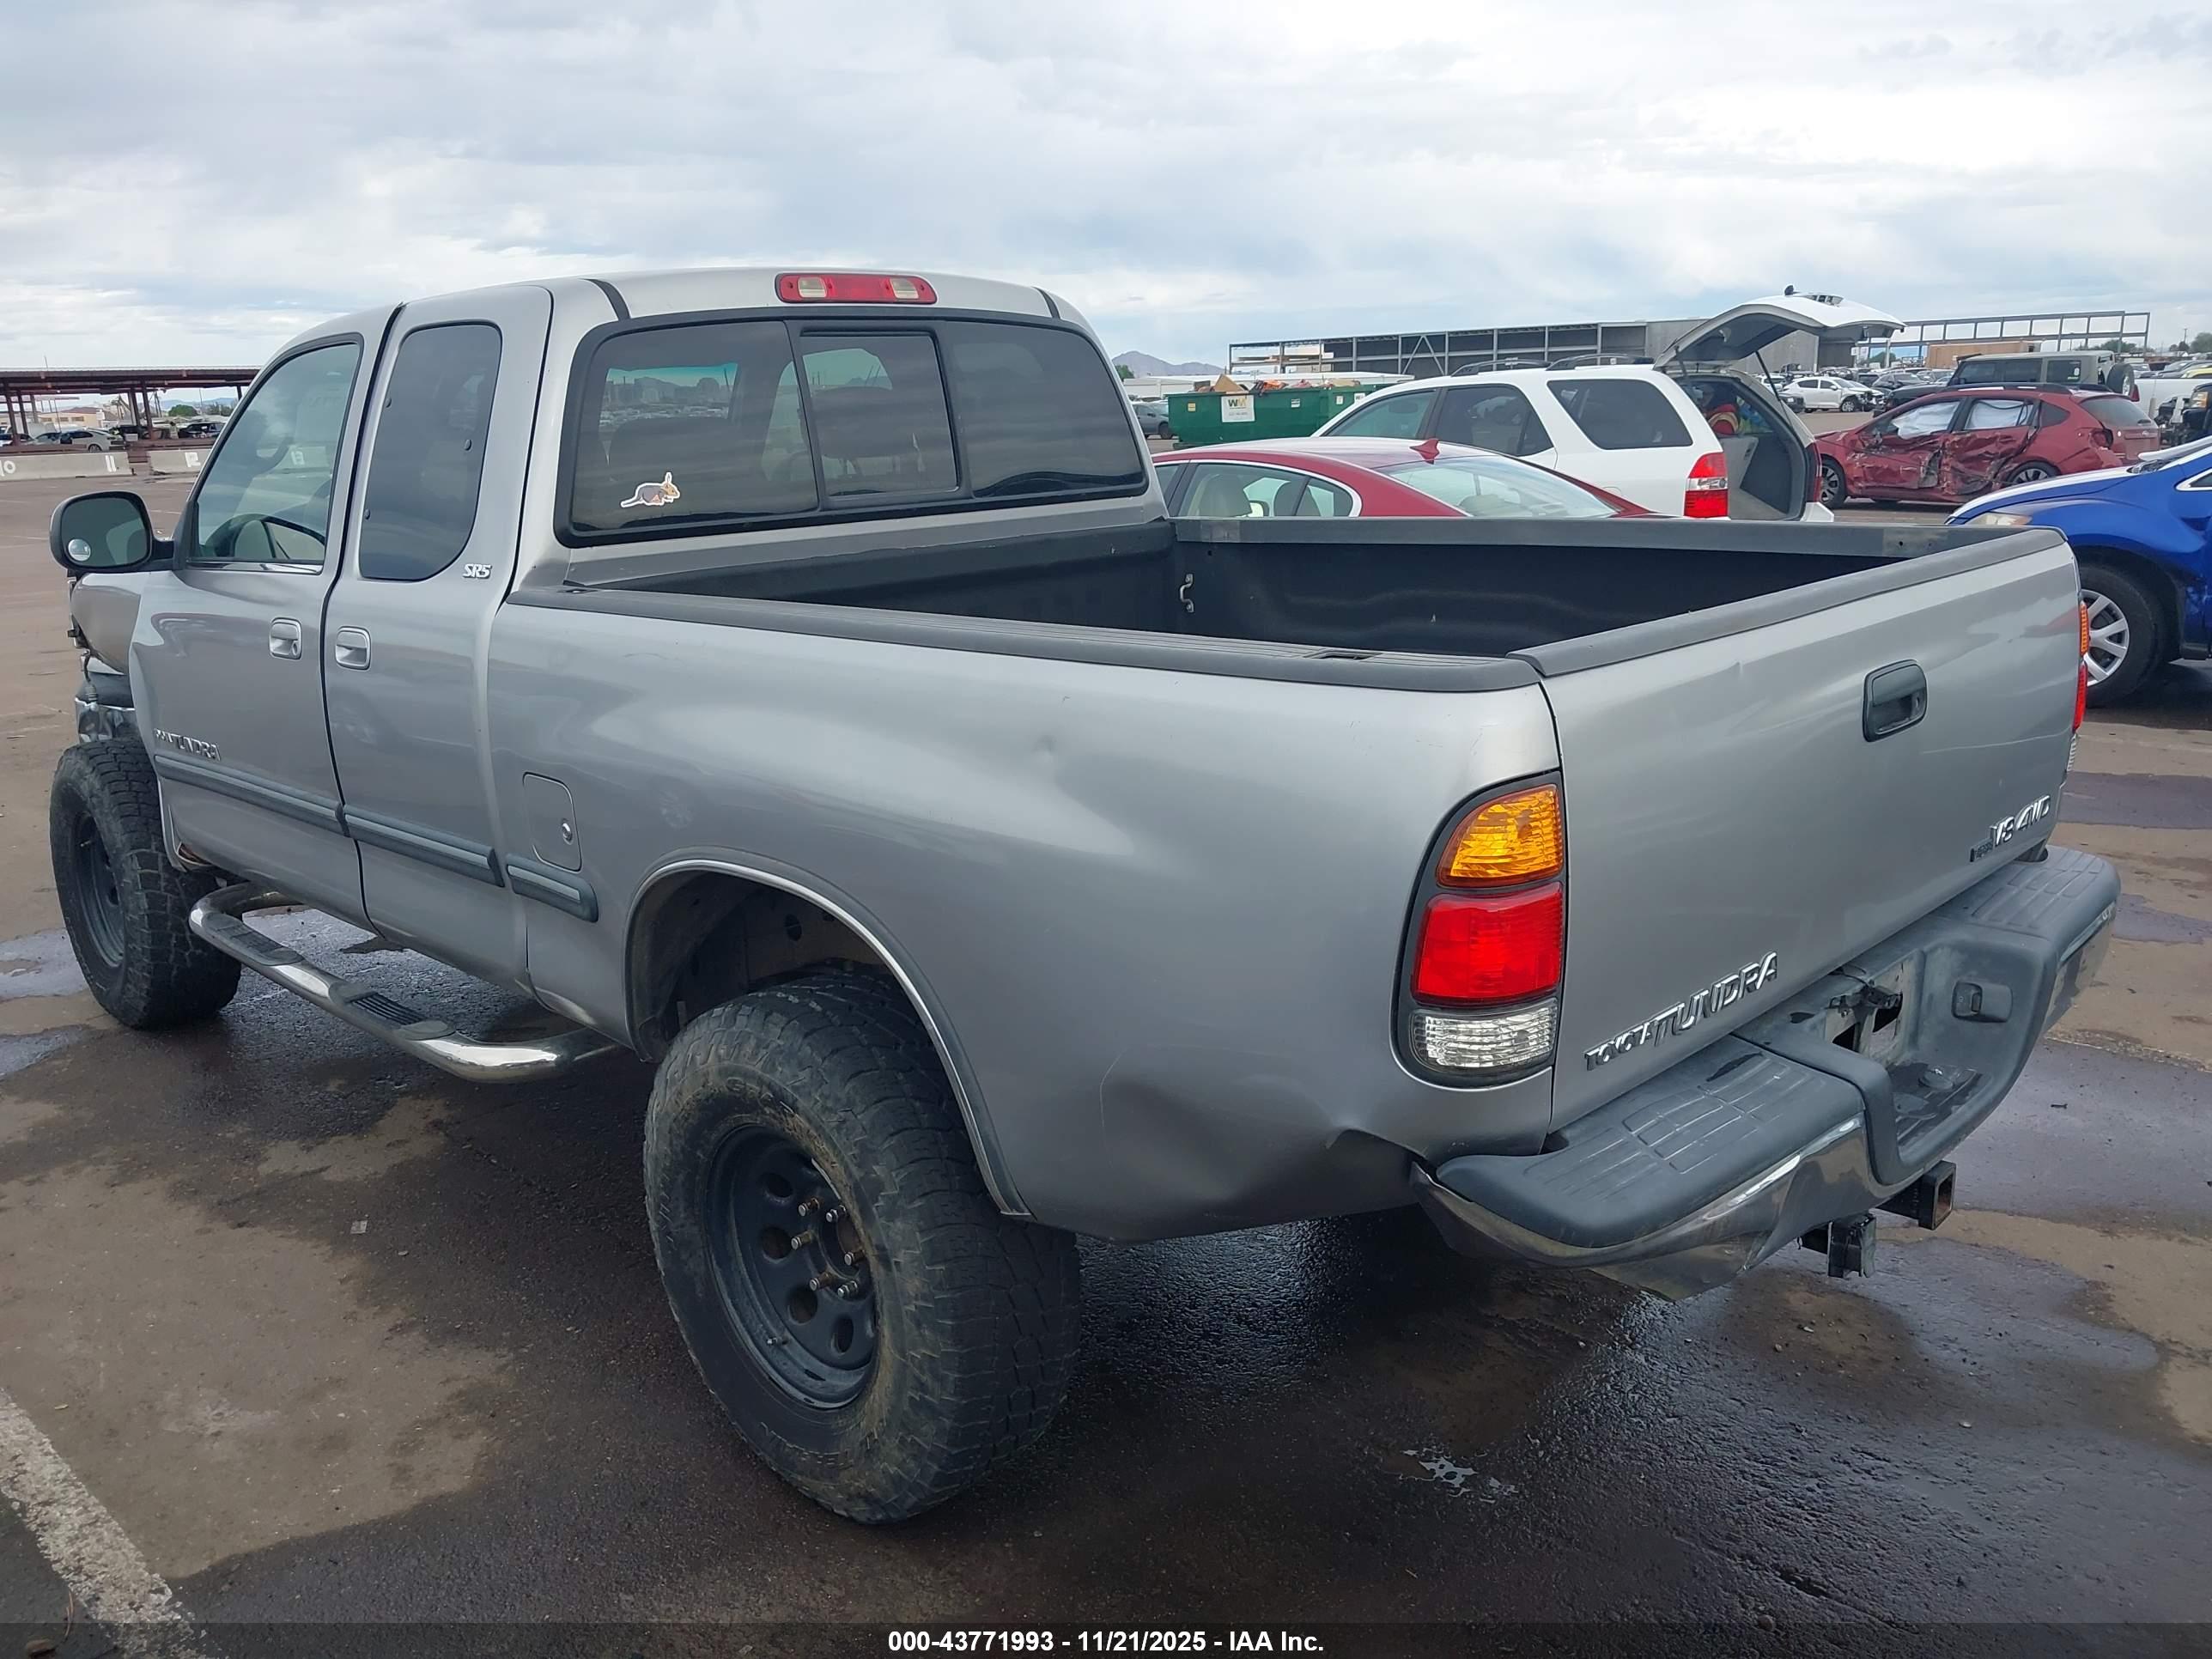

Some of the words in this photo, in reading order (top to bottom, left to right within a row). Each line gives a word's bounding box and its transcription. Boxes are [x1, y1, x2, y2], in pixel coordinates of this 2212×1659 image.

[1228, 398, 1247, 407] WM
[463, 563, 493, 580] SR5
[1990, 815, 2015, 848] V8
[2015, 794, 2051, 831] 4WD
[1583, 1020, 1653, 1072] TOYOTA
[1652, 951, 1778, 1048] TUNDRA
